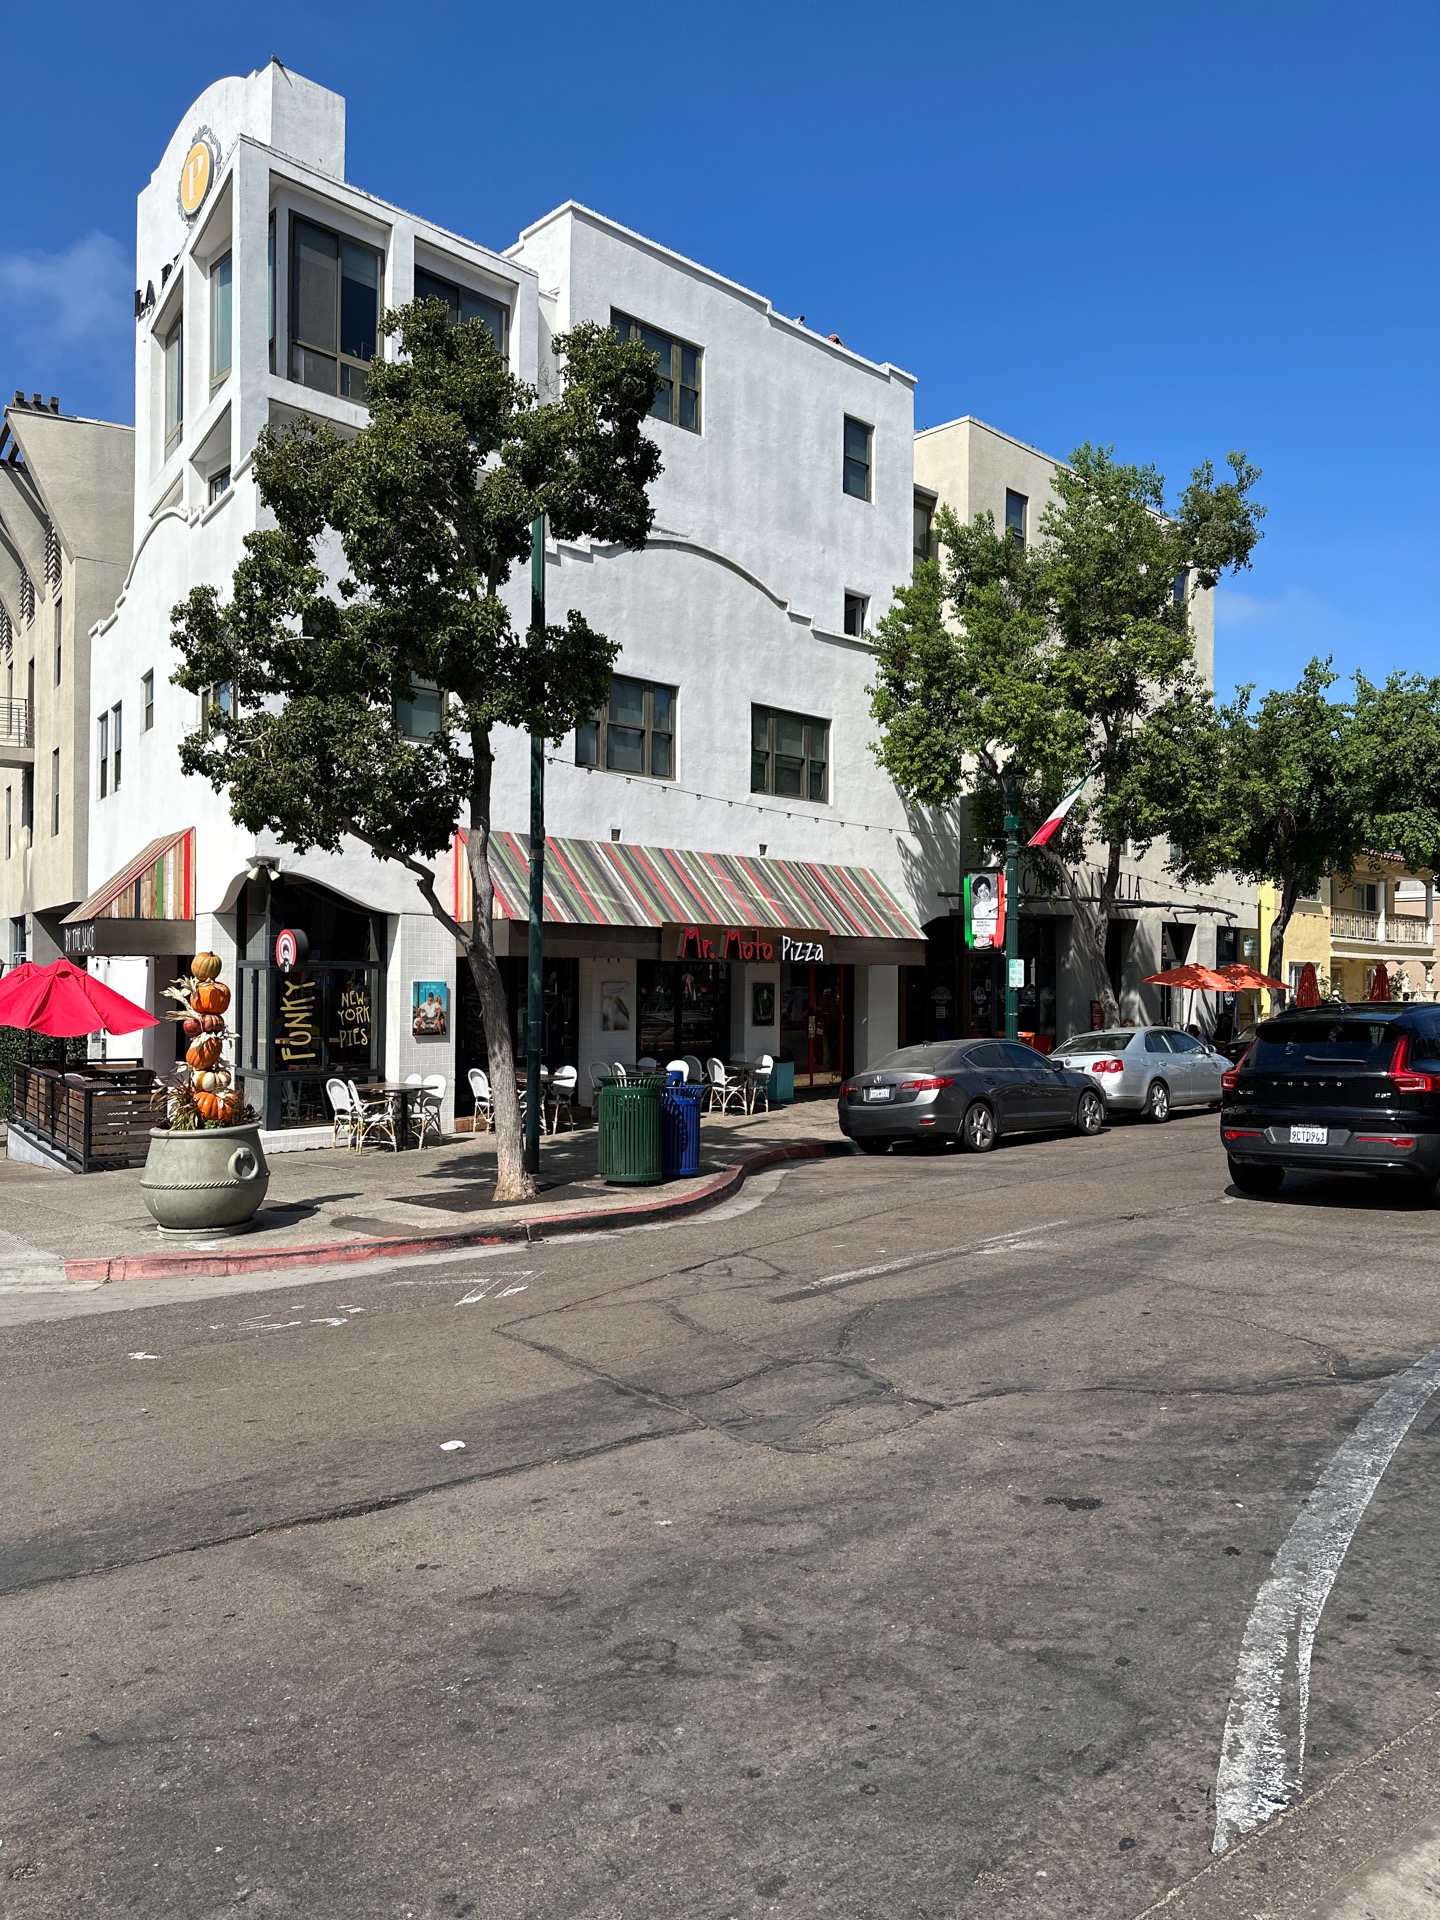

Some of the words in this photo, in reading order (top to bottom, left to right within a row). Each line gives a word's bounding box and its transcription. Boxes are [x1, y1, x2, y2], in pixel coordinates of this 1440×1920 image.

[1090, 871, 1141, 900] ITLIA
[680, 926, 716, 959] Mr.
[722, 928, 773, 960] Moto
[782, 935, 824, 961] Pizza
[341, 990, 365, 1007] NEW
[280, 980, 316, 1061] FUNKY
[337, 1005, 371, 1025] YORK
[339, 1027, 369, 1048] PIES
